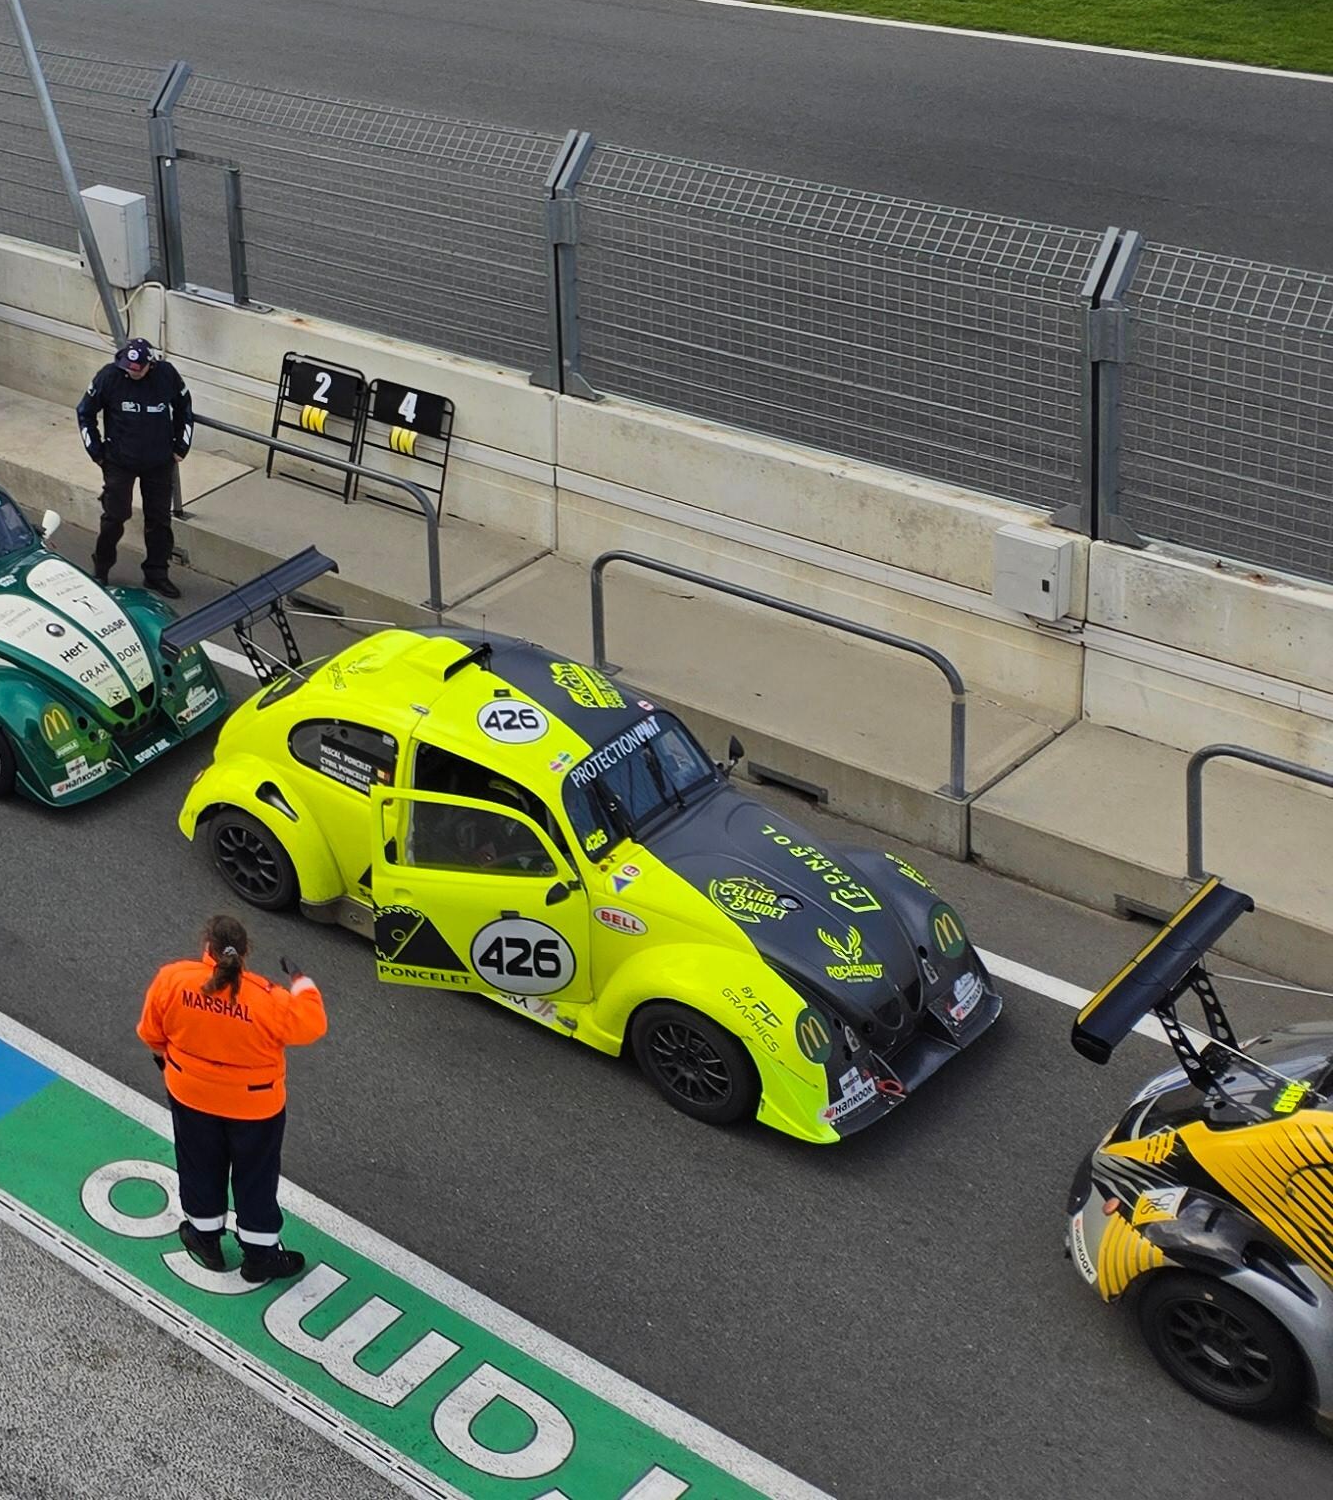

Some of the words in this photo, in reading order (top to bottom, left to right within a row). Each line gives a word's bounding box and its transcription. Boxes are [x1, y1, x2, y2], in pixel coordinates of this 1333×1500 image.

[313, 372, 332, 404] 2
[398, 392, 418, 423] 4
[96, 618, 127, 639] Lease
[60, 641, 89, 663] Hert
[79, 661, 111, 684] GRAN
[485, 708, 541, 732] 426
[585, 828, 608, 852] 426
[719, 881, 777, 906] CELLIER
[731, 897, 788, 921] BAUDET
[600, 910, 642, 933] BELL
[479, 936, 561, 979] 426
[379, 965, 473, 986] PONCELET
[181, 989, 254, 1026] MARSHAL
[721, 987, 780, 1053] GRAPHICS
